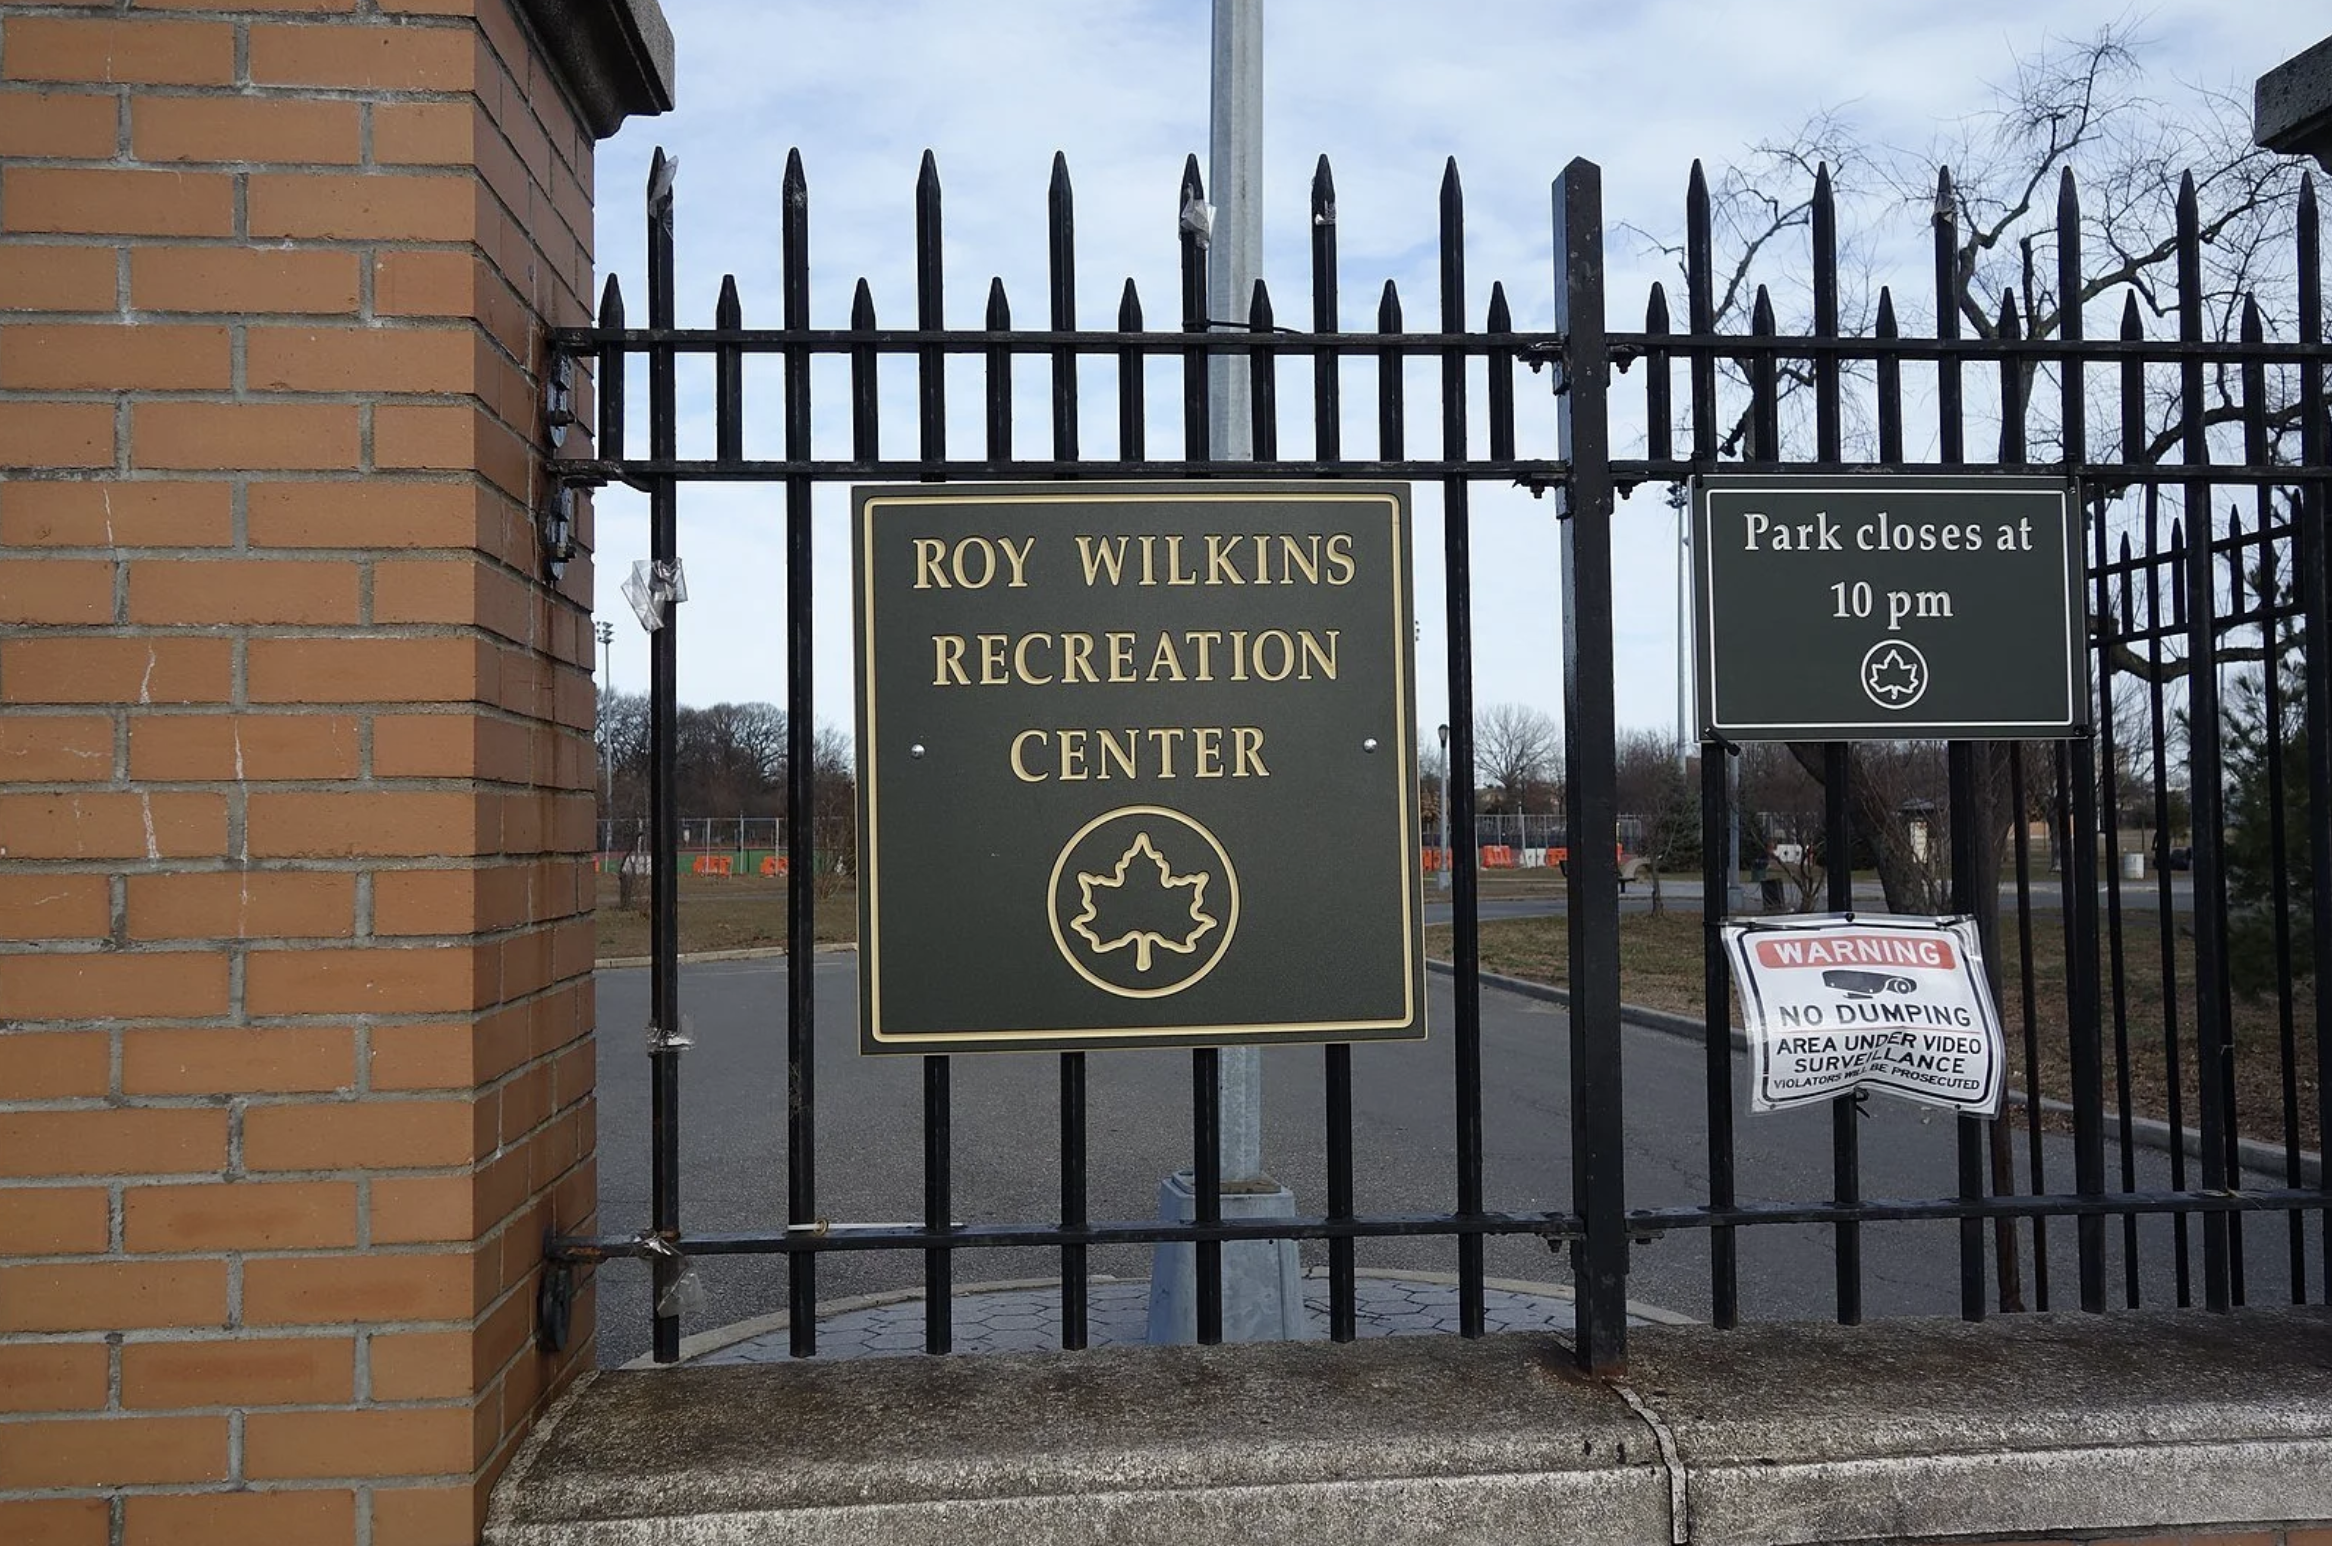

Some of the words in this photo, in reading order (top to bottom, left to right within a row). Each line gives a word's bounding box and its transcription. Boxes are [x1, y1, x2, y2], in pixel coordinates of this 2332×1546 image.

[1744, 511, 1843, 551] Park
[1856, 511, 1984, 551] closes
[1996, 516, 2034, 551] at
[912, 536, 1036, 589] ROY
[1075, 533, 1357, 586] WILKINS
[1830, 581, 1874, 618] 10
[1886, 588, 1954, 630] pm
[931, 629, 1341, 687] RECREATION
[1009, 726, 1270, 783] CENTER
[1773, 939, 1941, 966] WARNING
[1779, 1005, 1823, 1027] NO
[1836, 1004, 1971, 1027] DUMPING
[1776, 1036, 1841, 1055] AREA
[1844, 1031, 1917, 1052] UNDER
[1923, 1036, 1982, 1055] VIDEO
[1774, 1073, 1842, 1090] VIOLATORS
[1870, 1063, 1887, 1073] BE
[1891, 1067, 1980, 1090] PROSECUTED
[1794, 1047, 1966, 1074] SURVEILLANCE
